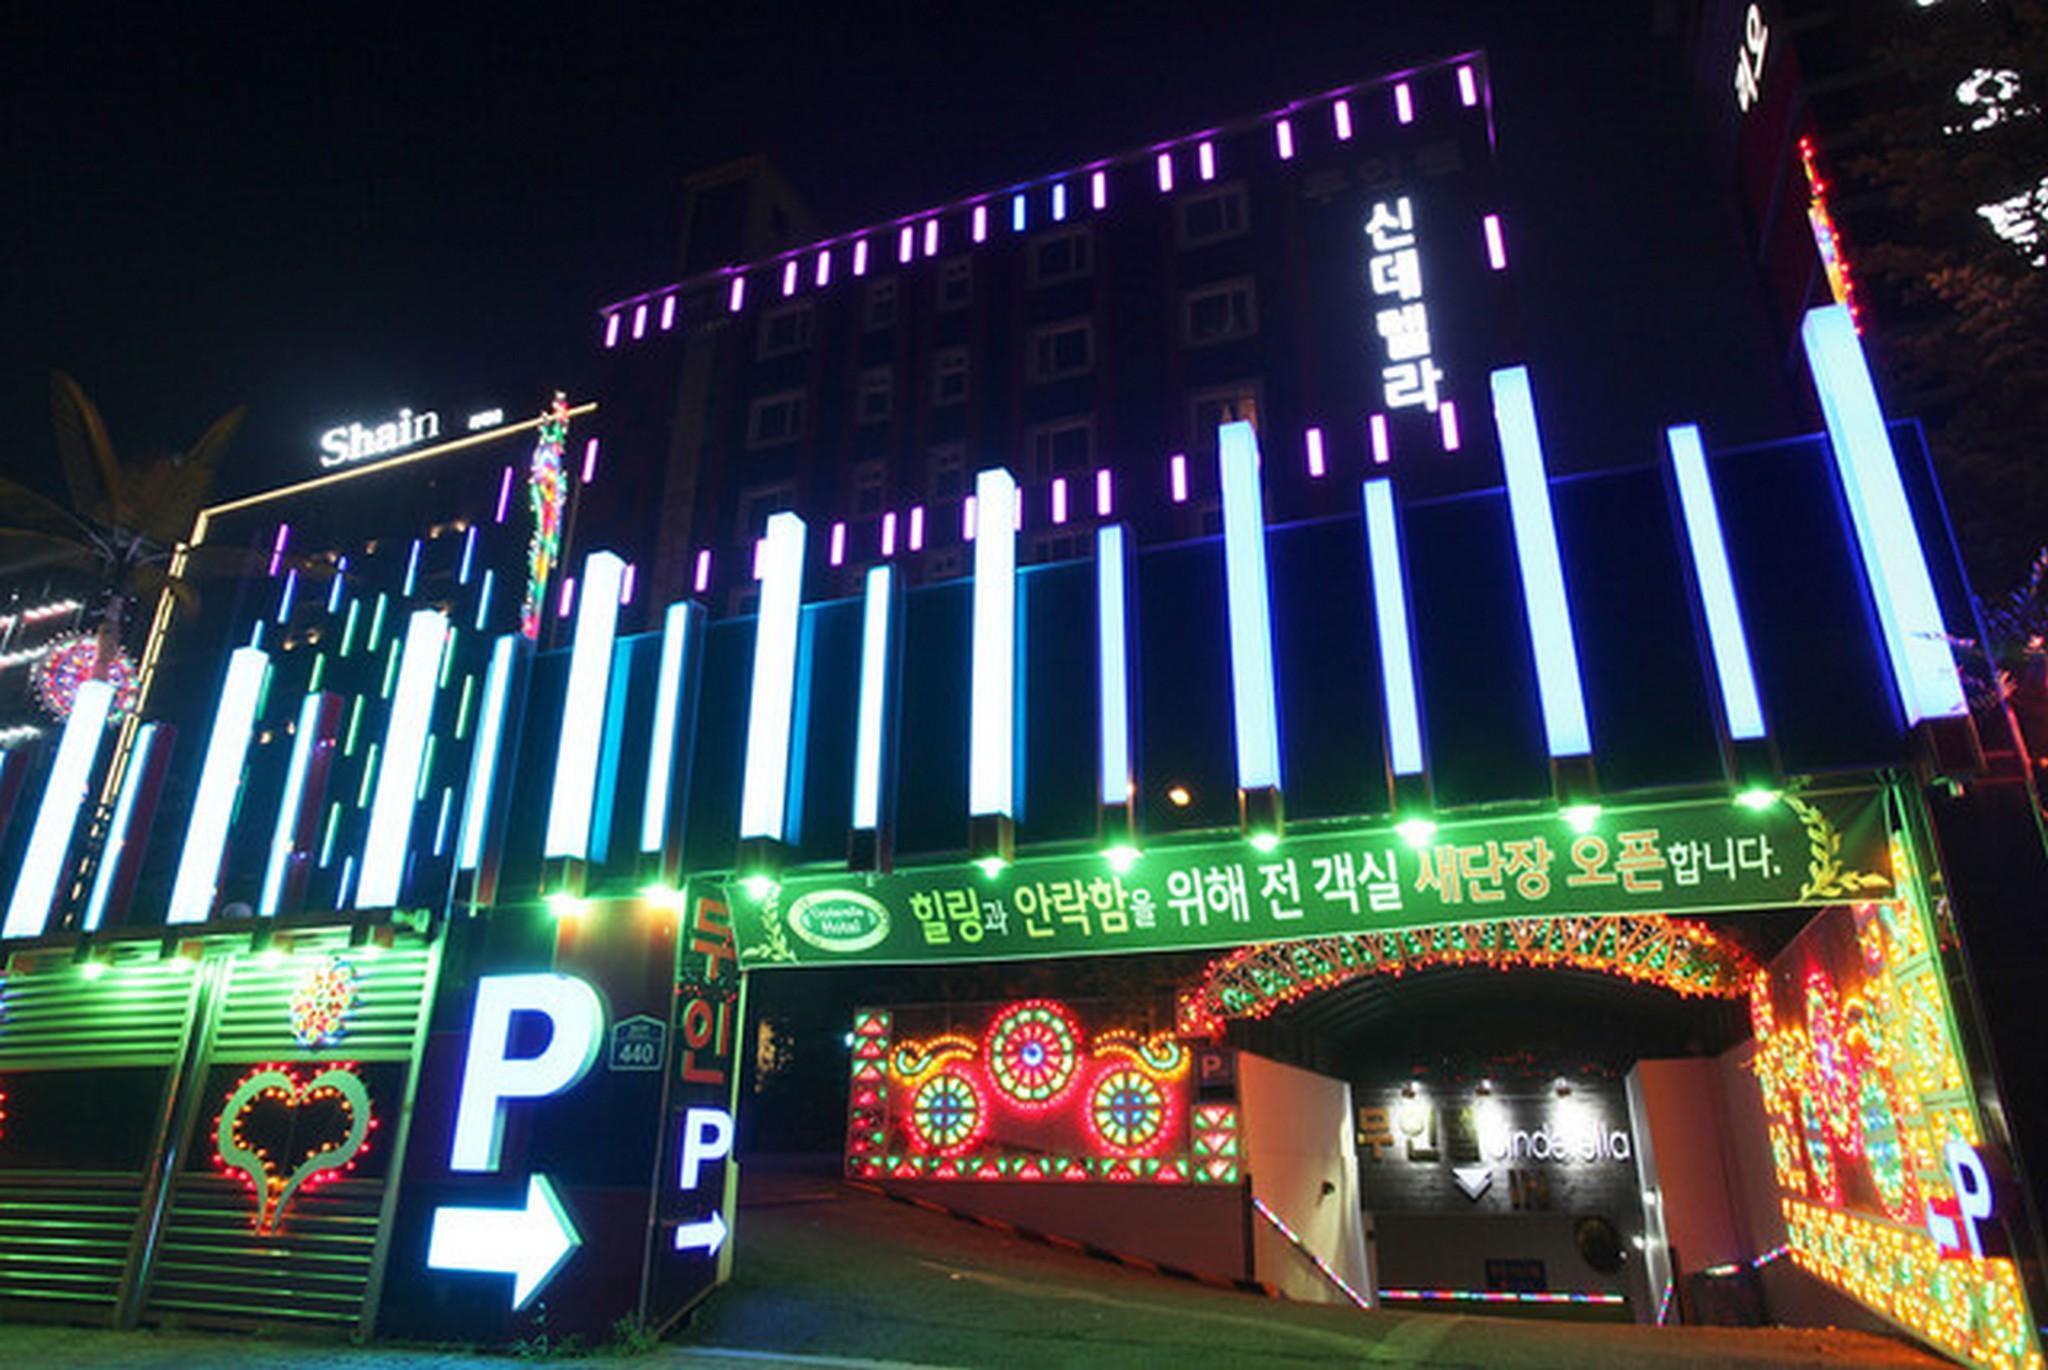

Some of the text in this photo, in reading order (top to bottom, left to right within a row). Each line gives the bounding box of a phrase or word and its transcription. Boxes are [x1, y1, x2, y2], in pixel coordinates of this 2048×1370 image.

[320, 408, 439, 467] Shain
[909, 828, 1781, 944] 힐링과 안락함을 위해 전 객실 새단장 오픈합니다.
[450, 972, 605, 1172] P
[619, 1042, 655, 1064] 440
[1200, 1054, 1222, 1080] P
[680, 1107, 735, 1189] P
[1481, 1121, 1630, 1162] indeella
[1944, 1138, 1993, 1259] P
